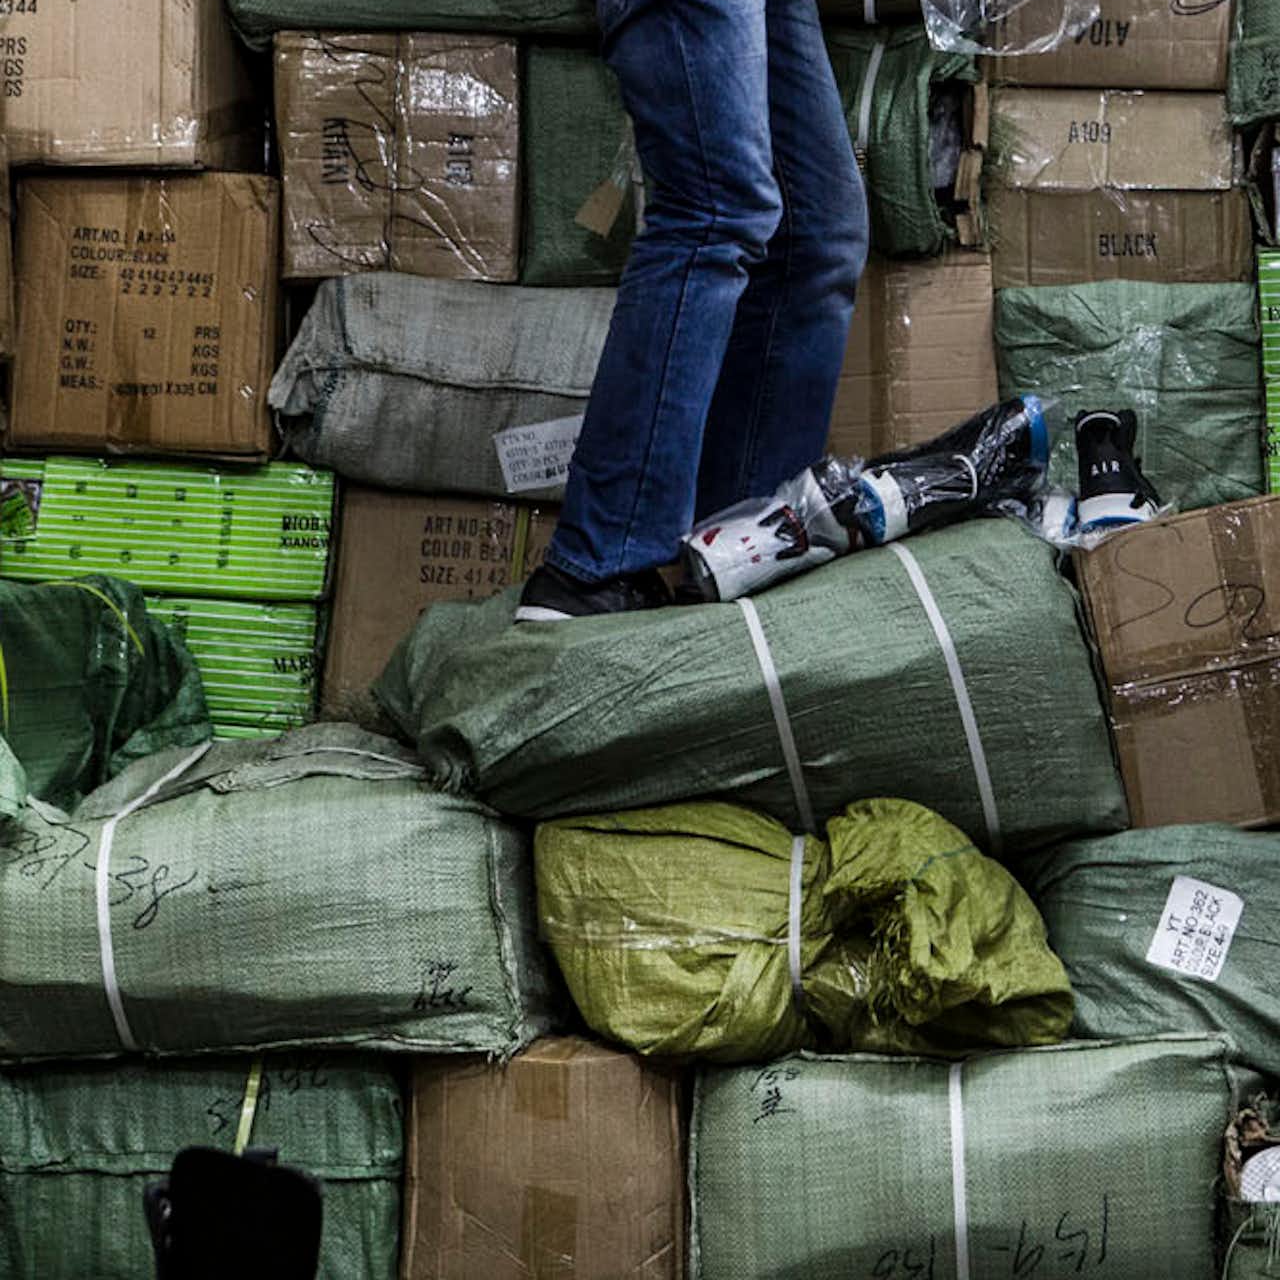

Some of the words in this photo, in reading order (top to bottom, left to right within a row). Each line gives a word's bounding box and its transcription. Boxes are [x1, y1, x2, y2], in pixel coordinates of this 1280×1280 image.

[1068, 120, 1112, 144] A109
[321, 116, 350, 187] KHAKI
[1098, 233, 1158, 258] BLACK
[191, 344, 220, 359] KGS
[190, 363, 219, 377] KGS
[1091, 459, 1121, 477] AIR
[463, 566, 482, 585] 41
[487, 566, 507, 586] 42
